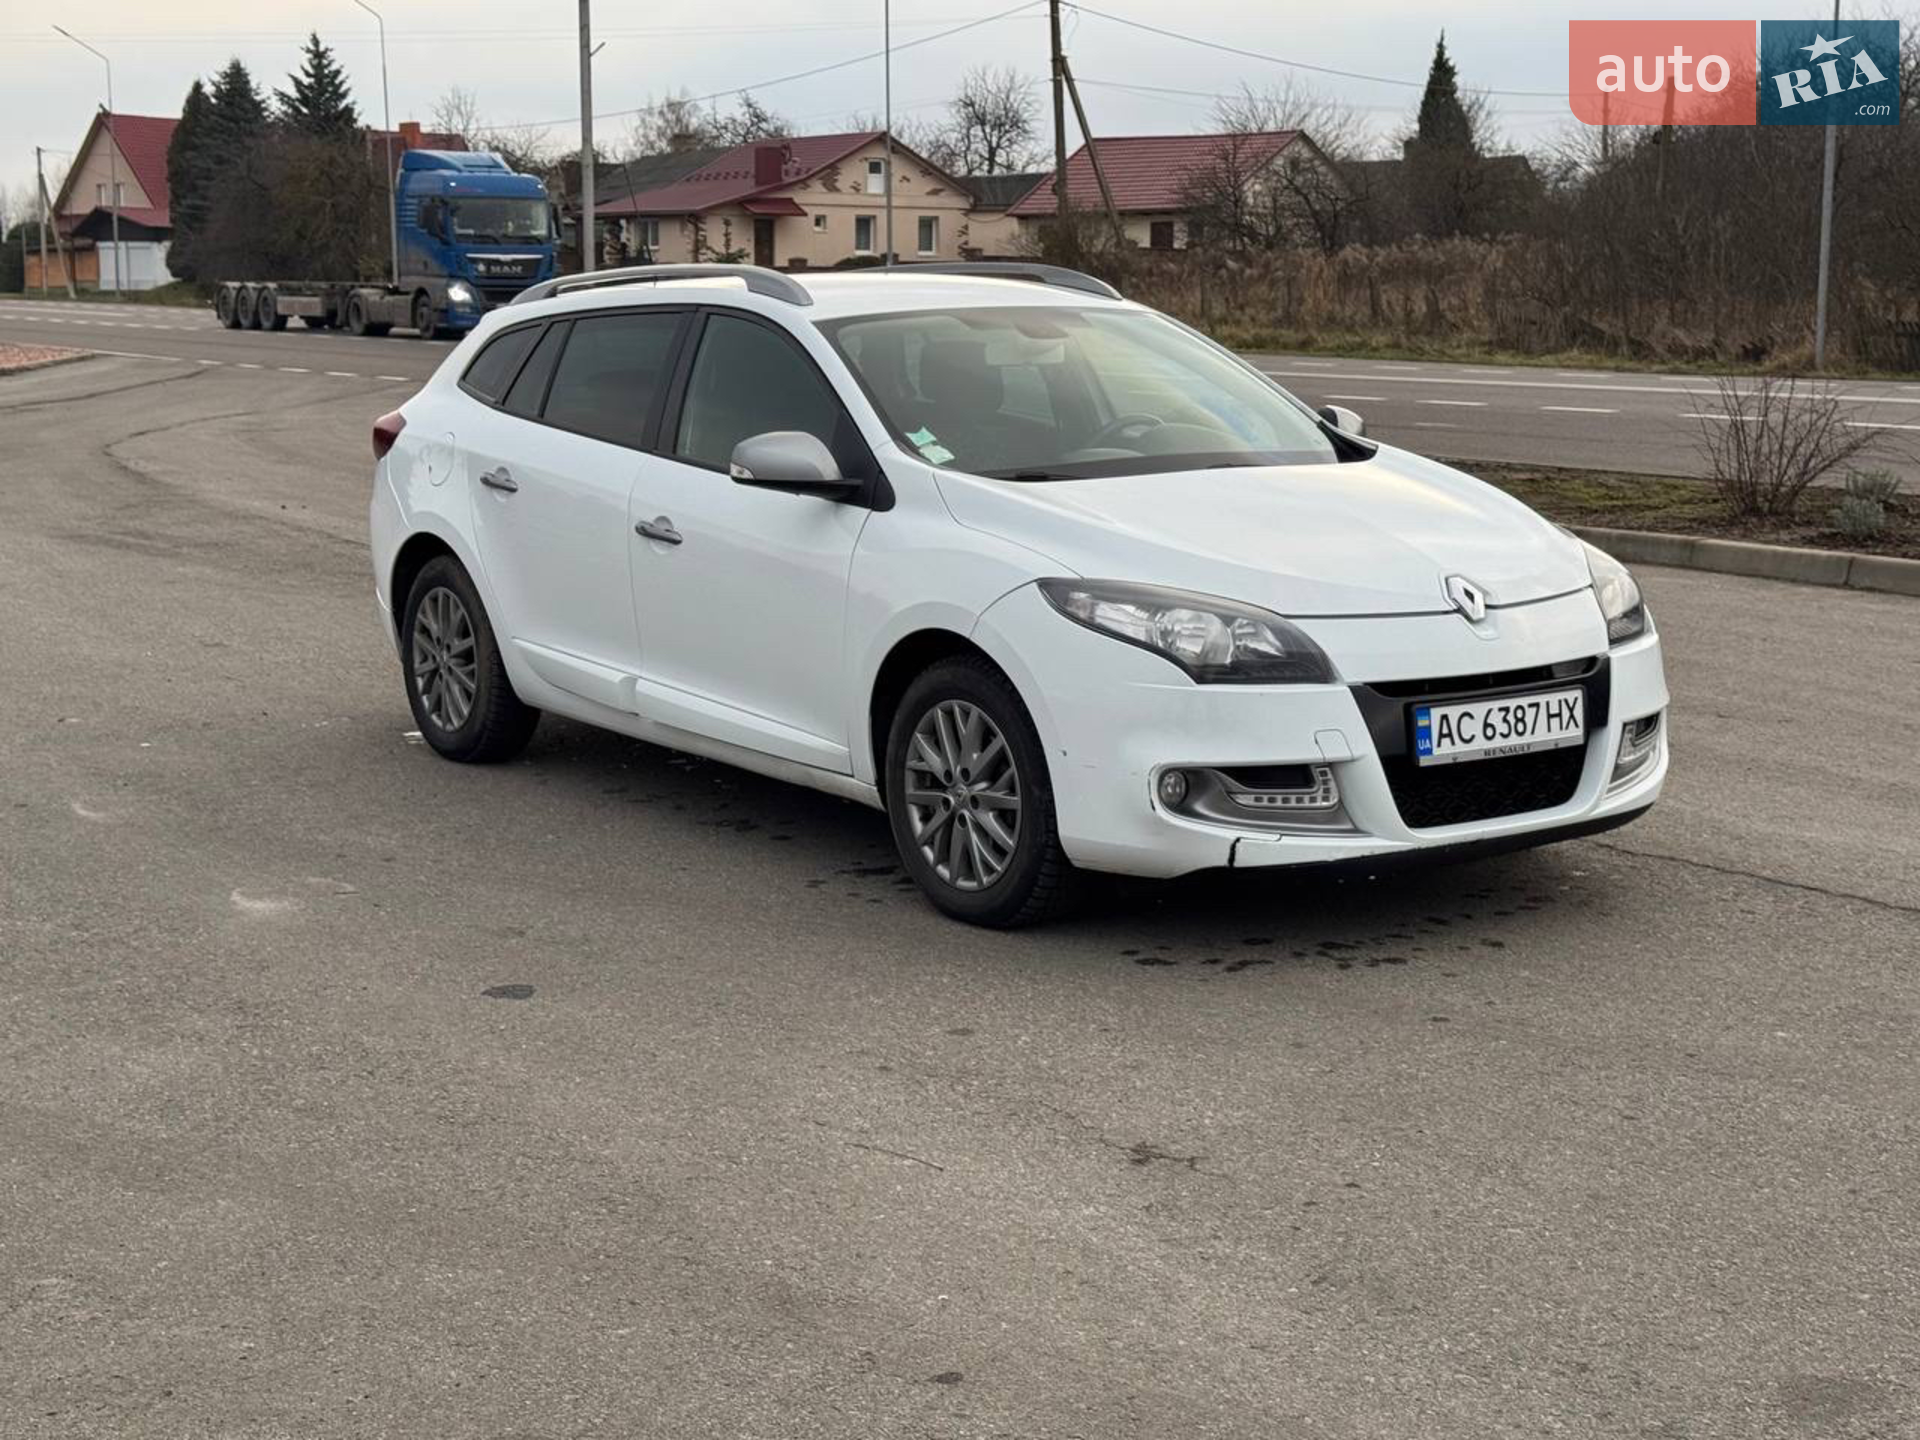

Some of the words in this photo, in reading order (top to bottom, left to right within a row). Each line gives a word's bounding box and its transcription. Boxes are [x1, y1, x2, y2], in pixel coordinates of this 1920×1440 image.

[490, 265, 523, 274] MAN
[1437, 711, 1476, 748] AC
[1482, 702, 1540, 741] 6387
[1546, 697, 1579, 732] HX
[1418, 738, 1431, 750] UA
[1484, 745, 1532, 757] RENAULT
